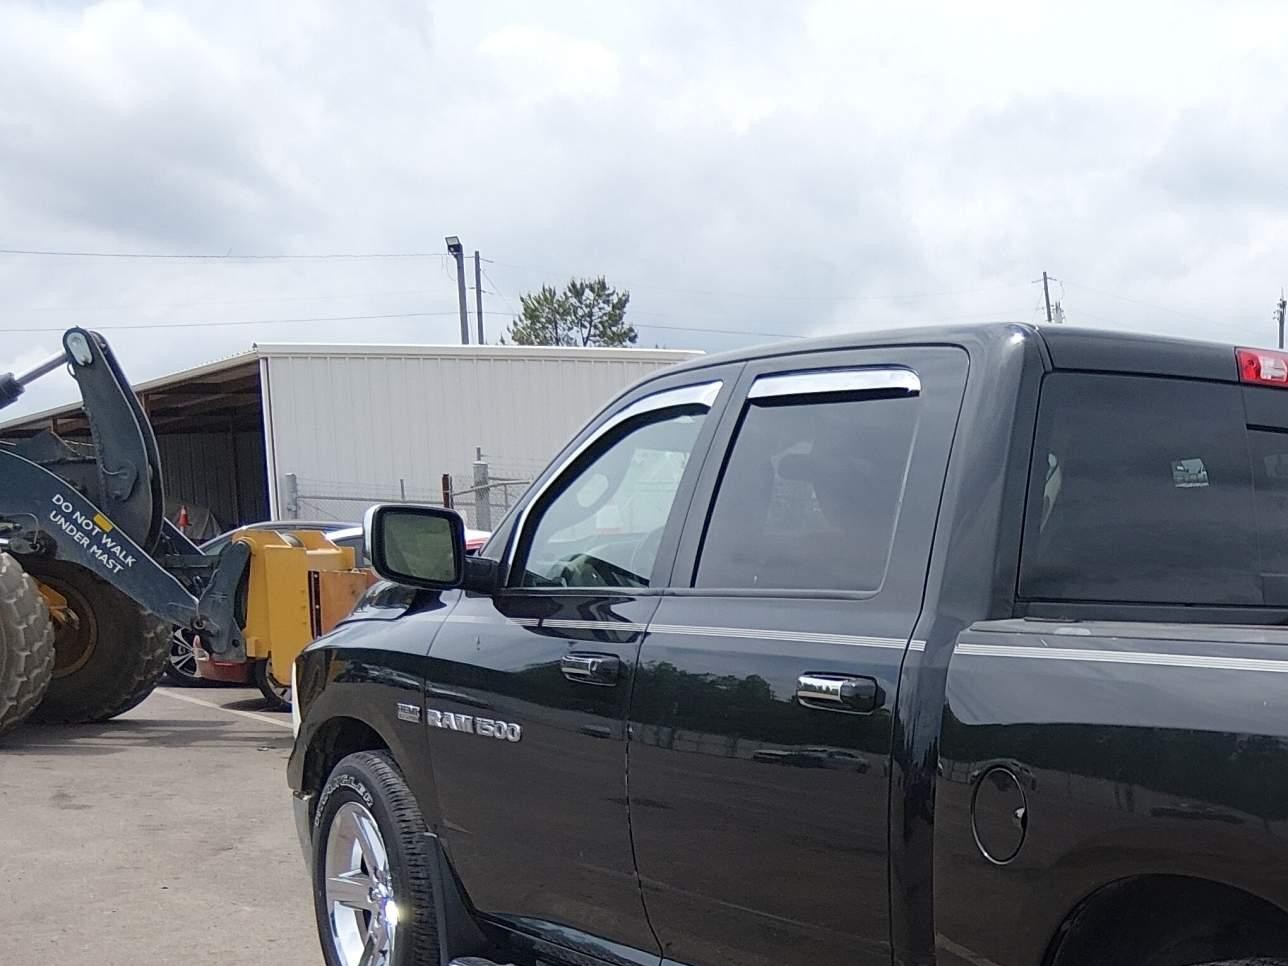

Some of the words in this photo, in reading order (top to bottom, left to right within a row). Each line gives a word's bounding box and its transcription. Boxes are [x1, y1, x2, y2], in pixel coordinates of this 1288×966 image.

[49, 510, 91, 549] UNDER
[89, 544, 124, 574] MAST
[52, 493, 73, 513] DO
[72, 511, 102, 536] NOT
[101, 533, 137, 568] WALK
[427, 708, 474, 734] RAM
[475, 717, 522, 742] 1500
